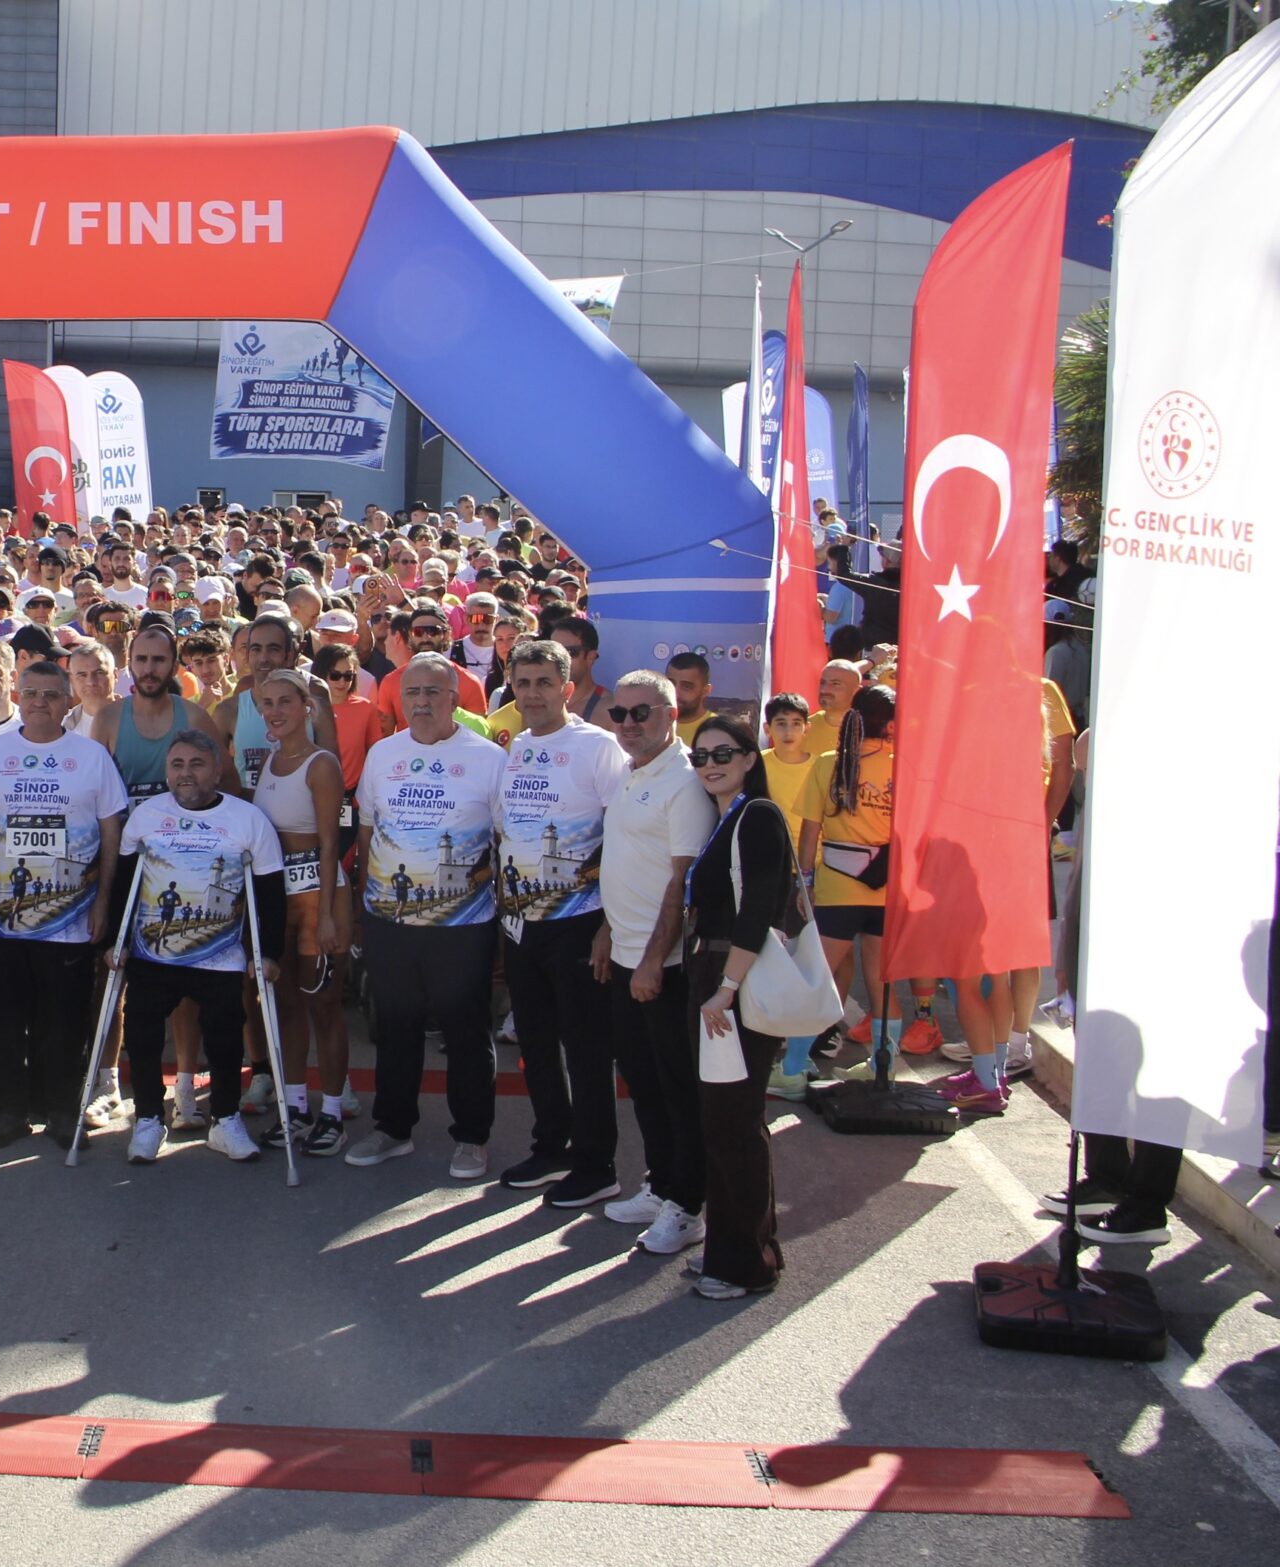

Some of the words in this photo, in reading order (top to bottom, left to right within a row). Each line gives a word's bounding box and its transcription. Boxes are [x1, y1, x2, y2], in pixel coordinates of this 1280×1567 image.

[29, 202, 47, 246] /
[68, 200, 283, 245] FINISH
[221, 355, 246, 366] SİNOP
[247, 356, 275, 367] EĞİTİM
[230, 366, 262, 375] VAKFI
[253, 382, 282, 394] SİNOP
[283, 382, 315, 395] EĞİTİM
[317, 385, 344, 397] VAKFI
[249, 393, 277, 406] SİNOP
[279, 396, 298, 407] YARI
[300, 398, 351, 411] MARATONU
[228, 413, 259, 432] TÜM
[265, 415, 365, 437] SPORCULARA
[246, 432, 346, 453] BAŞARILAR!
[1134, 511, 1225, 540] GENÇLİK
[1232, 520, 1254, 543] VE
[1145, 540, 1253, 573] BAKANLIĞI
[13, 782, 60, 793] SİNOP
[512, 779, 549, 791] SİNOP
[4, 793, 23, 802] YARI
[24, 794, 70, 805] MARATONU
[398, 787, 445, 800] SİNOP
[504, 790, 518, 799] YARI
[519, 791, 559, 803] MARATONU
[387, 798, 406, 807] YARI
[407, 799, 456, 810] MARATONU
[13, 831, 56, 846] 57001
